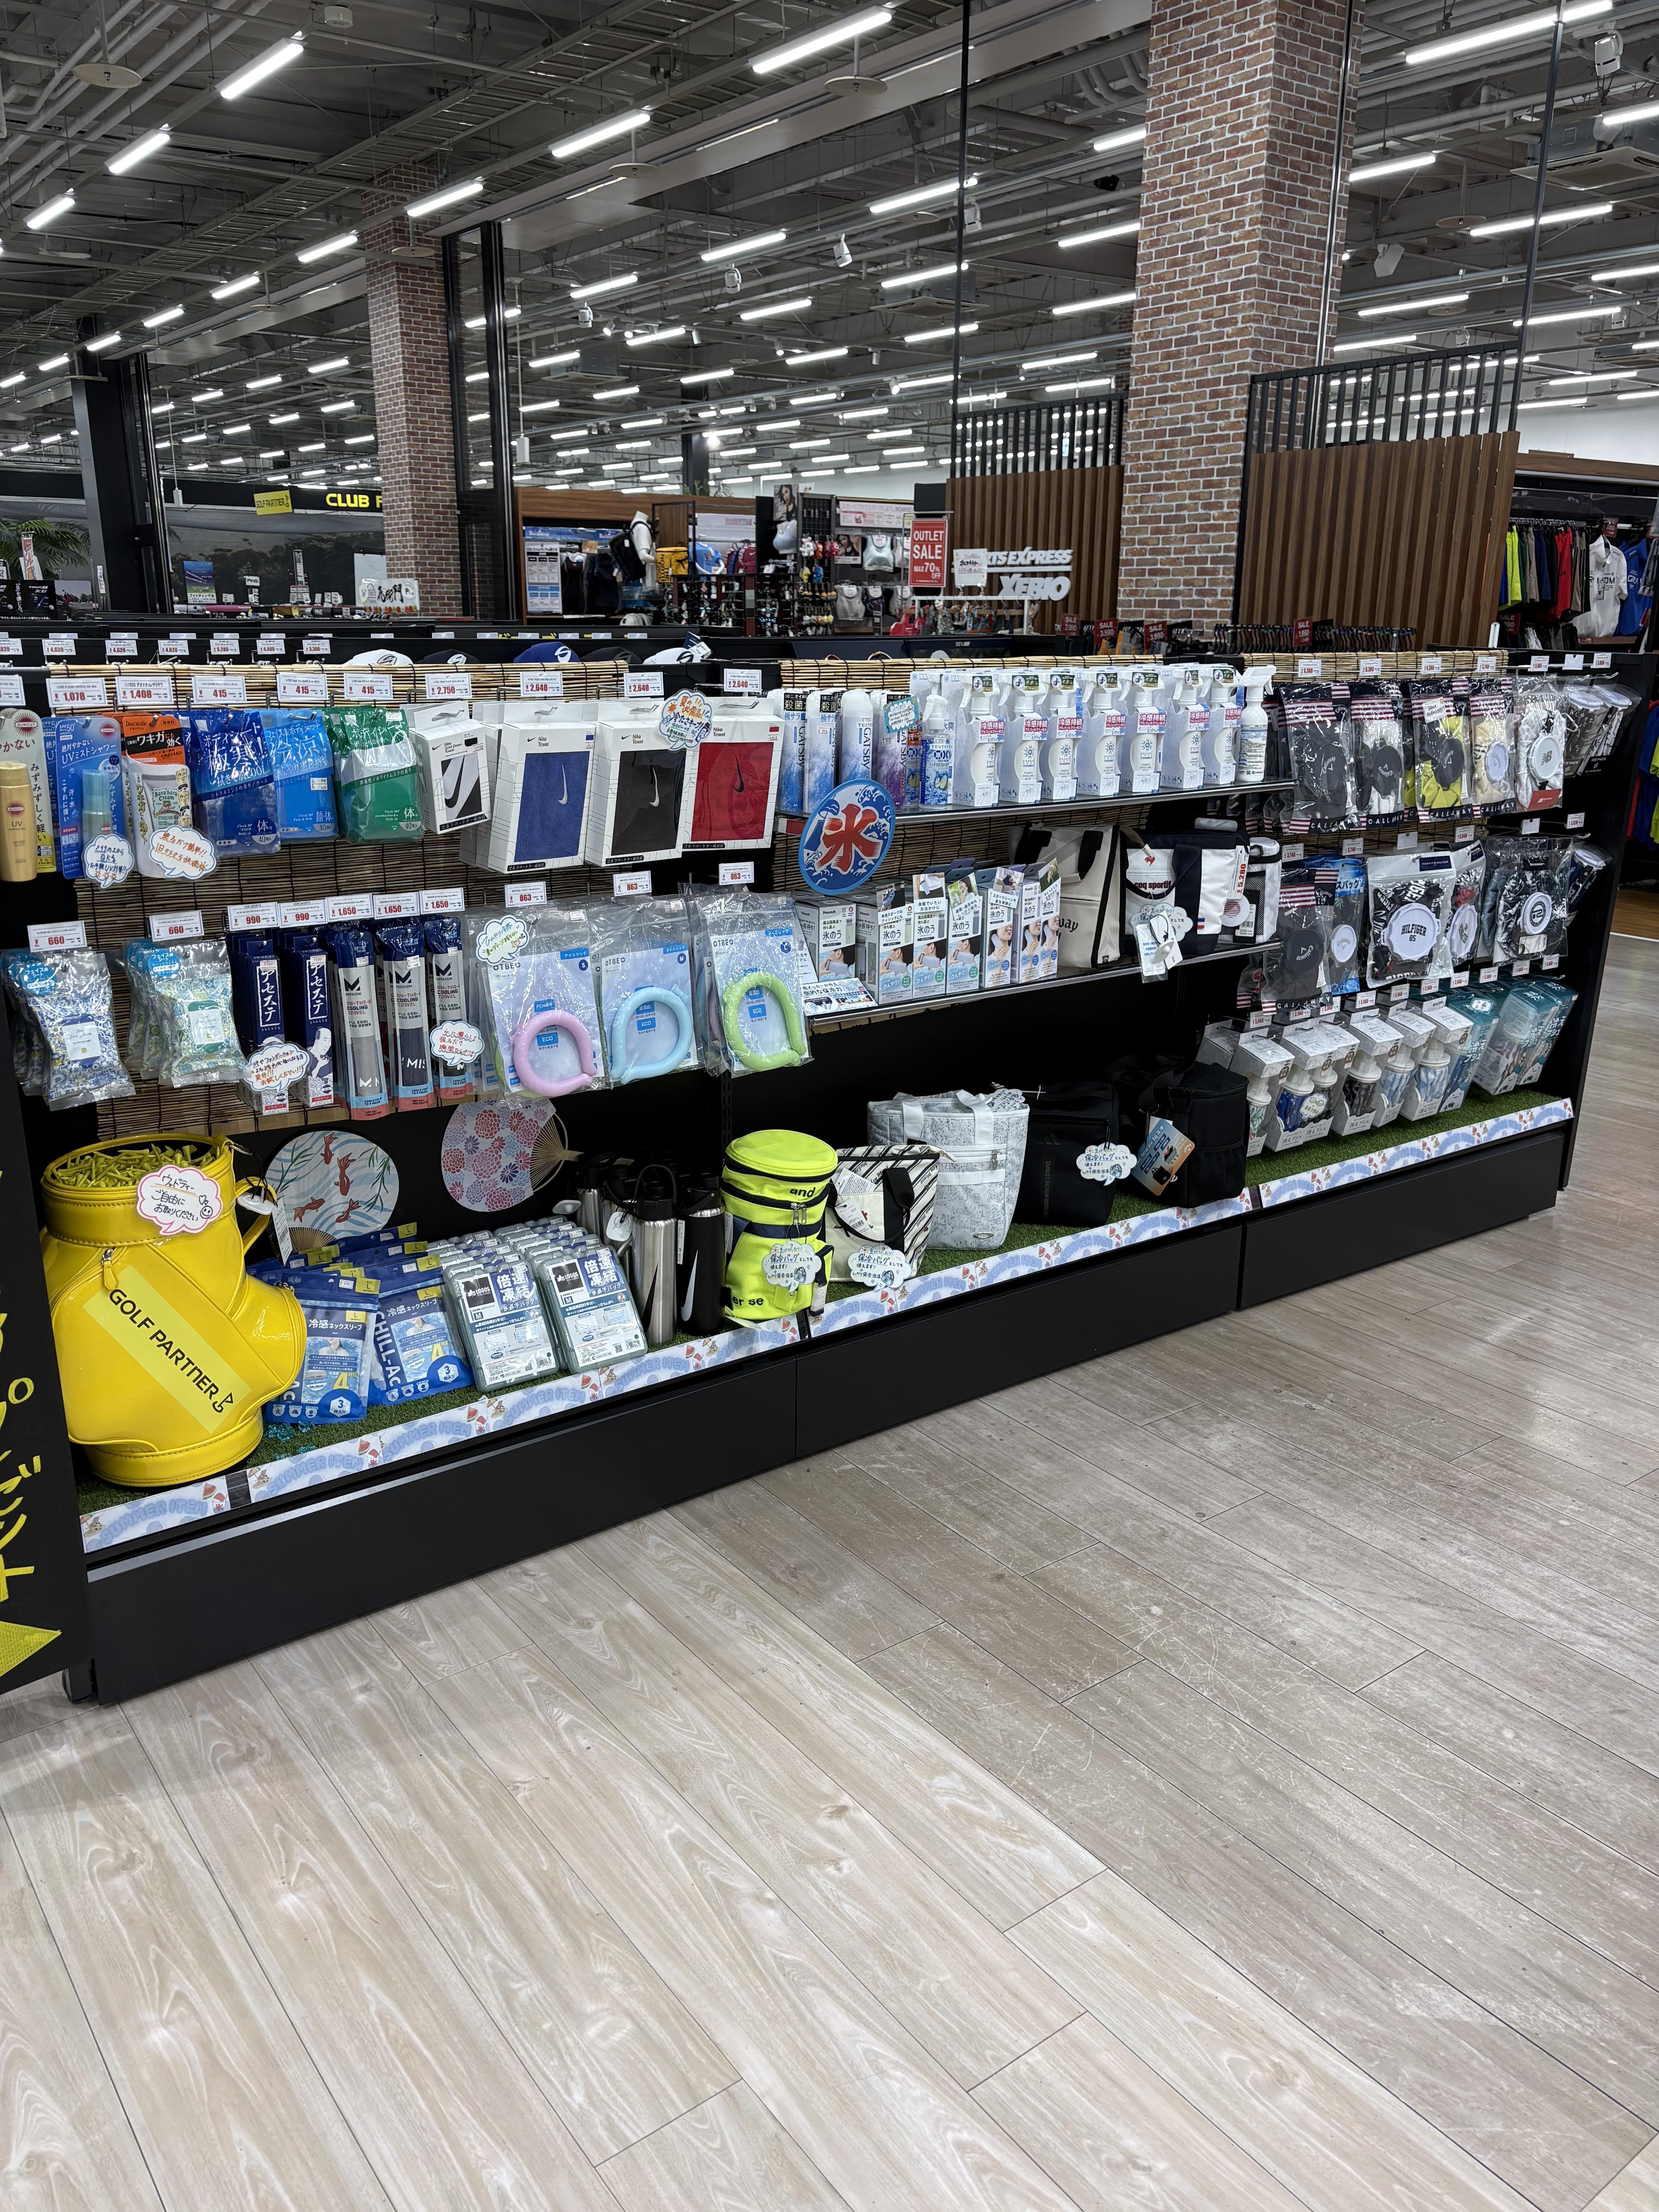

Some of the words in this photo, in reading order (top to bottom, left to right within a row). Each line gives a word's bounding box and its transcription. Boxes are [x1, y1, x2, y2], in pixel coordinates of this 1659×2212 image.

[326, 493, 369, 508] CLUB
[914, 531, 944, 541] OUTLET
[912, 544, 942, 560] SALE
[1007, 547, 1074, 565] EXPRESS
[998, 574, 1072, 601] XEBIO
[1297, 620, 1309, 629] SALE
[295, 685, 309, 694] 415
[362, 685, 374, 694] 415
[530, 684, 548, 692] 2,640
[633, 684, 649, 692] 2,640
[732, 680, 748, 689] 2,640
[129, 690, 152, 699] 1,408
[212, 689, 227, 698] 415
[437, 686, 455, 695] 2,750
[63, 692, 85, 701] 1,078
[679, 696, 692, 707] 夏の
[981, 721, 1004, 730] 冷感持続
[1025, 720, 1048, 728] 冷感持続
[1059, 718, 1083, 726] 冷感持続
[62, 739, 93, 752] 絶対やかない
[861, 728, 872, 769] GATSBY
[62, 744, 117, 765] UVミストシャワー
[1321, 756, 1336, 774] Callaway
[1135, 881, 1147, 890] coq
[1149, 880, 1171, 890] sportif
[519, 893, 532, 902] 863
[383, 905, 402, 914] 1,650
[431, 900, 449, 909] 1,650
[338, 907, 356, 915] 1,650
[990, 910, 1005, 919] 氷のう
[246, 915, 261, 924] 990
[295, 912, 309, 921] 990
[168, 926, 184, 934] 660
[917, 924, 935, 935] 氷のう
[952, 921, 970, 932] 氷のう
[1401, 924, 1427, 937] HILFIGER
[822, 930, 842, 940] 氷のう
[883, 929, 902, 940] 氷のう
[48, 936, 65, 945] 660
[1084, 1153, 1115, 1161] 保冷バッグ
[161, 1174, 195, 1192] ウッドティー
[151, 1189, 186, 1206] ご自由に
[789, 1187, 816, 1198] and
[153, 1203, 199, 1222] お取りください
[770, 1253, 800, 1263] 保冷バッグ
[857, 1253, 890, 1265] 保冷バッグ
[584, 1257, 614, 1274] 倍速
[564, 1272, 579, 1280] LOGOS
[588, 1270, 618, 1286] 凍結
[475, 1286, 491, 1295] LOGOS
[500, 1284, 530, 1302] 凍結
[591, 1282, 622, 1296] 氷点下パック
[907, 1278, 943, 1305] SUMMER
[943, 1277, 966, 1291] ITEM
[503, 1298, 535, 1312] 氷点下パック
[748, 1297, 764, 1306] se
[821, 1302, 860, 1332] SUMMER
[860, 1301, 885, 1316] ITEM
[109, 1288, 155, 1330] GOLF
[149, 1328, 219, 1401] PARTNER
[444, 1365, 451, 1374] 3
[614, 1357, 661, 1393] SUMMER
[662, 1356, 690, 1372] ITEM
[333, 1372, 349, 1390] 4
[338, 1399, 344, 1408] 3
[381, 1422, 437, 1460] SUMMER
[438, 1421, 472, 1437] ITEM
[266, 1455, 326, 1496] SUMMER
[328, 1455, 363, 1471] ITEM
[101, 1498, 168, 1545] SUMMER
[168, 1498, 208, 1516] ITEM
